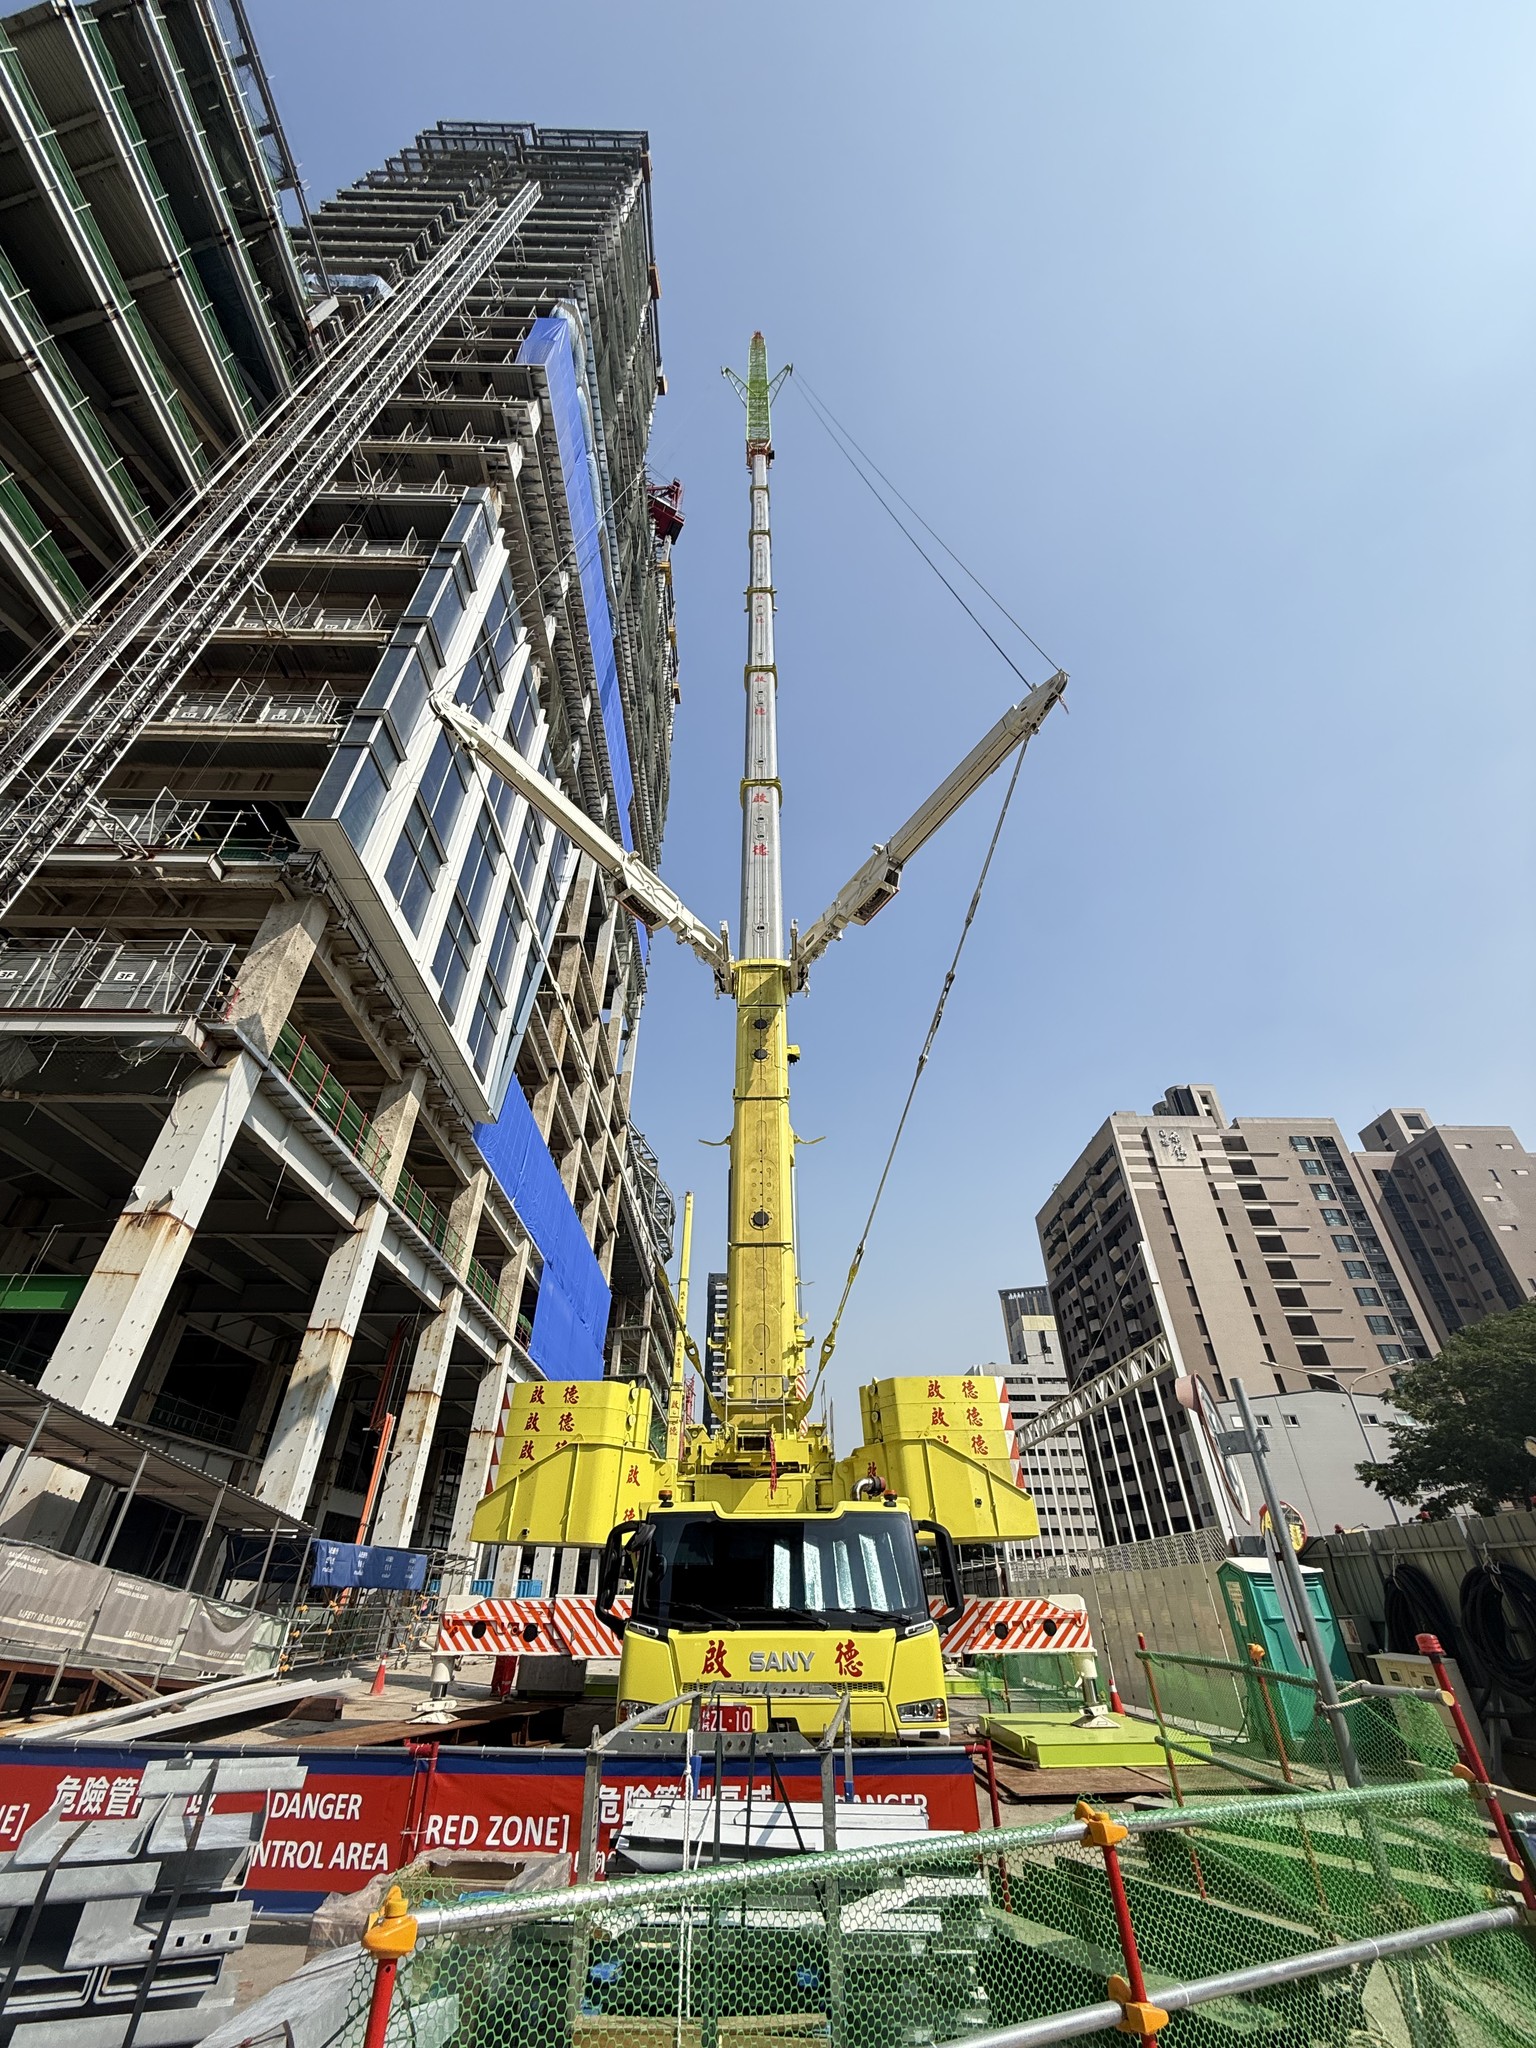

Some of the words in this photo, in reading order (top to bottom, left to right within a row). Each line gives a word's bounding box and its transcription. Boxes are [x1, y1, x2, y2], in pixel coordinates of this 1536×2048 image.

[971, 1434, 989, 1456] 德
[701, 1639, 732, 1678] 啟
[749, 1650, 815, 1672] SANY
[834, 1638, 864, 1678] 德
[270, 1792, 363, 1821] DANGER
[424, 1814, 479, 1846] RED
[485, 1814, 570, 1854] ZONE]
[250, 1840, 325, 1870] NTROL
[328, 1842, 389, 1871] AREA
